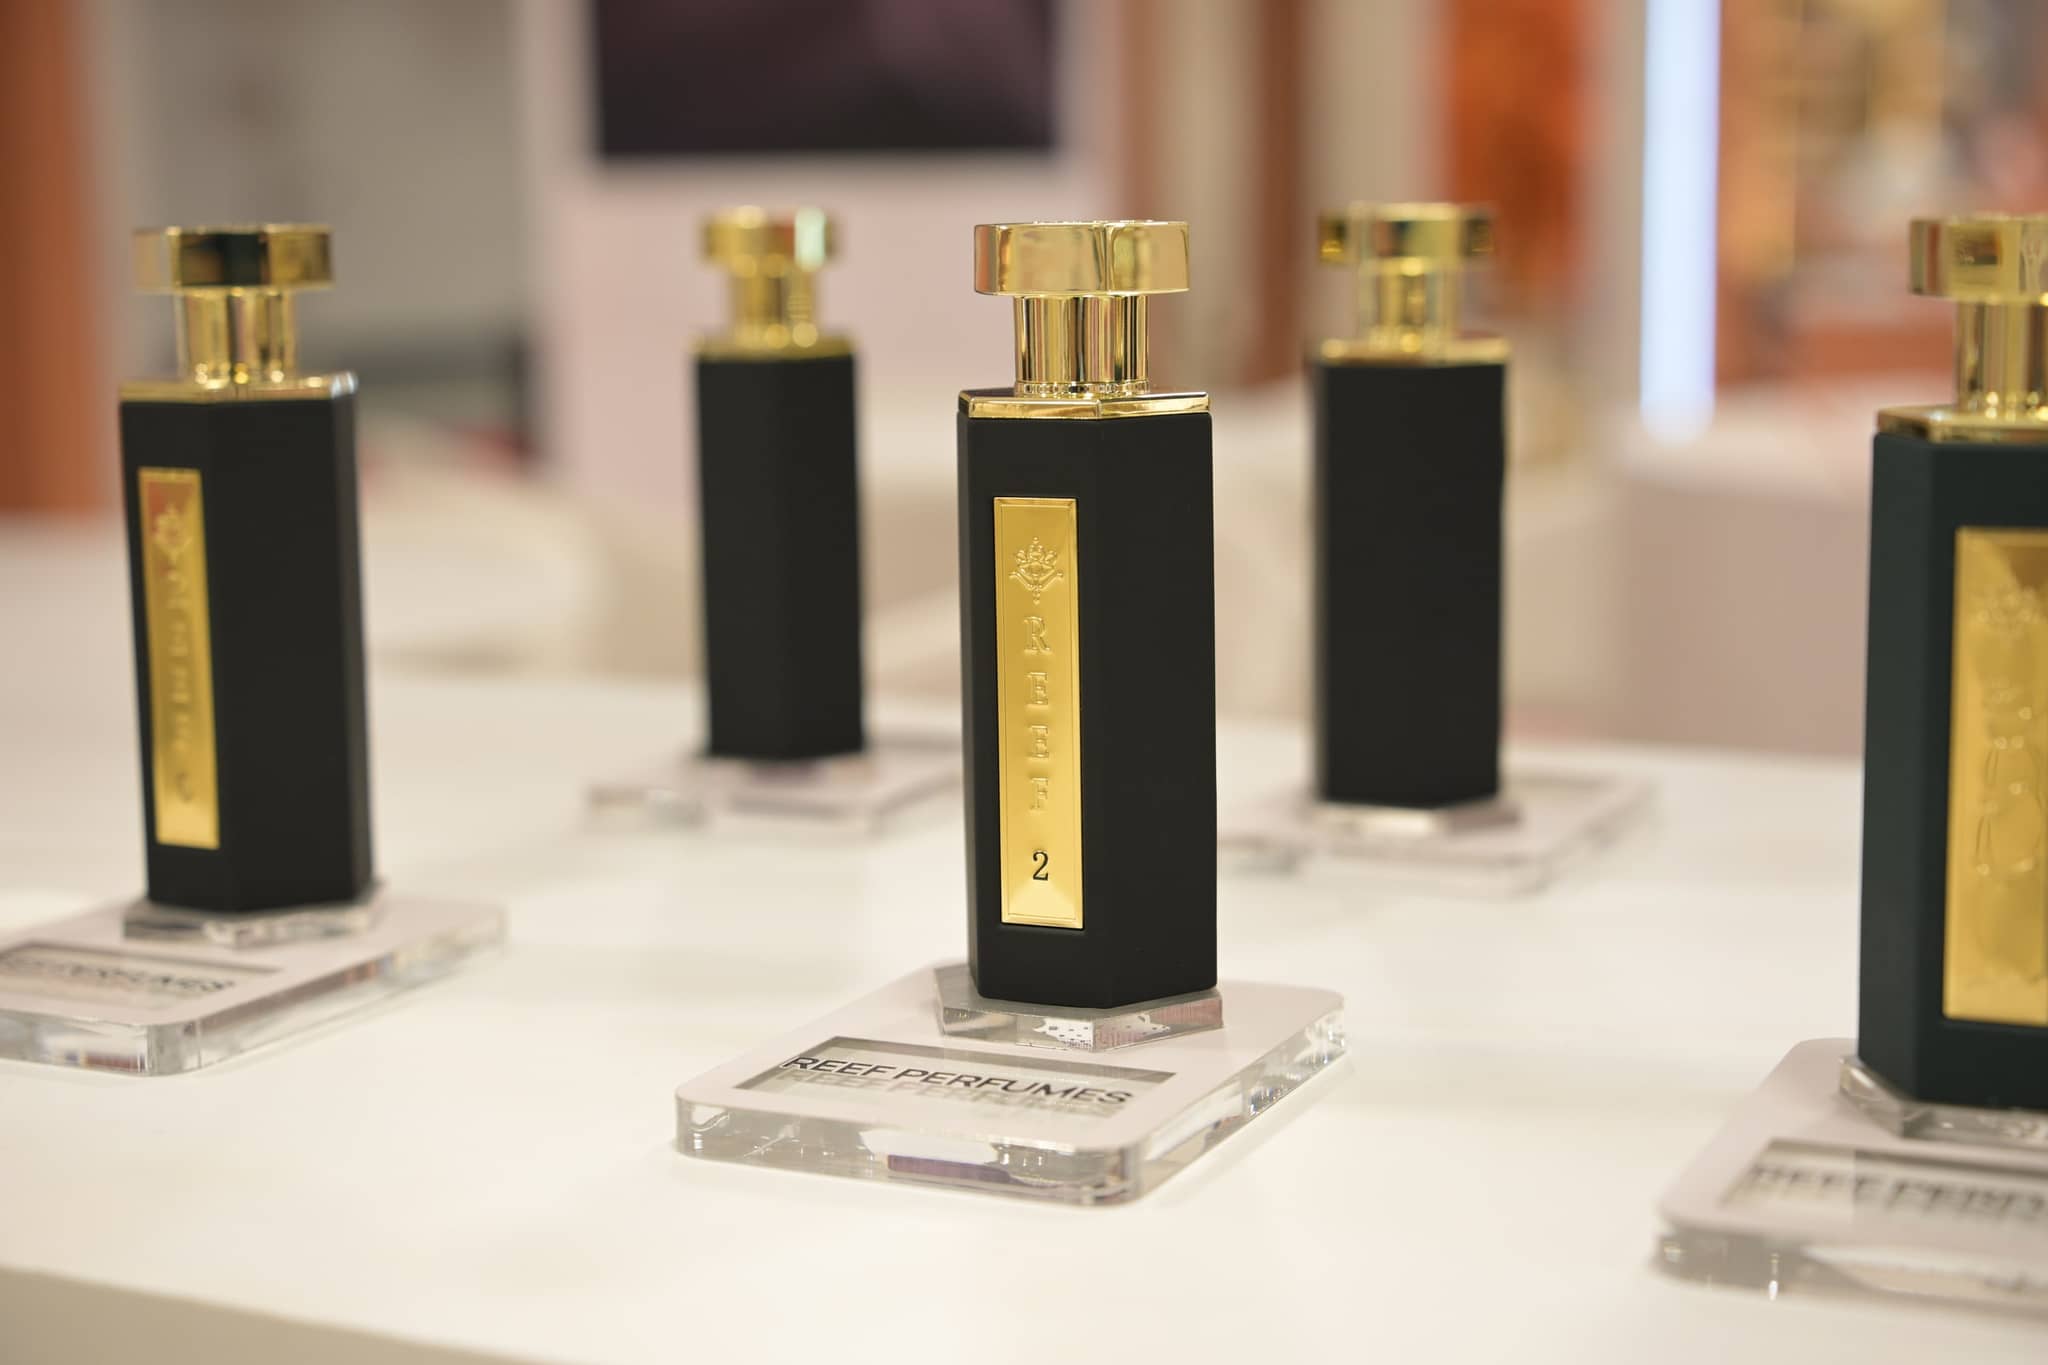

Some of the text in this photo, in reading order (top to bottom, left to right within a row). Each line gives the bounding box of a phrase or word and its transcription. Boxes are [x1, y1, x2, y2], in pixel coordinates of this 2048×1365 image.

[1023, 616, 1051, 811] REEF
[1032, 850, 1049, 881] 2
[782, 1056, 1133, 1105] REEF PERFUMES
